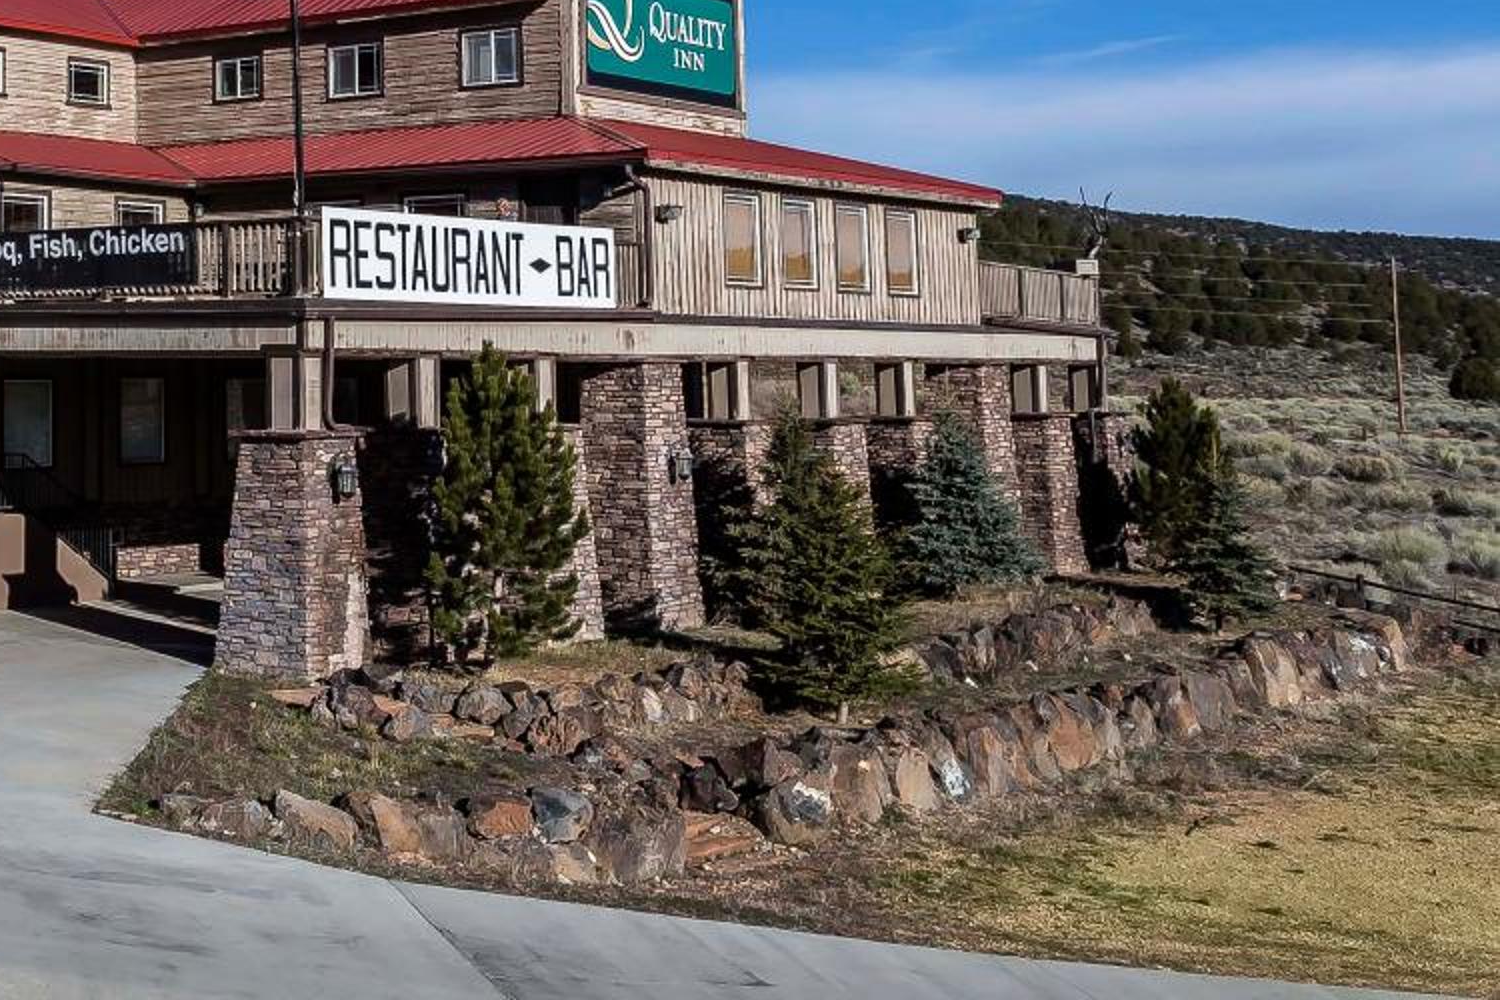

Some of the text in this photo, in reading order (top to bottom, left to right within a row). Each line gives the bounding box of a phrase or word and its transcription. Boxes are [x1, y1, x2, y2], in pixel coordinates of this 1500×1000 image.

[649, 1, 727, 51] QUALITY
[672, 47, 706, 72] INN
[29, 232, 84, 262] Fish,
[89, 227, 184, 256] Chicken
[329, 218, 611, 299] RESTAURANT BAR
